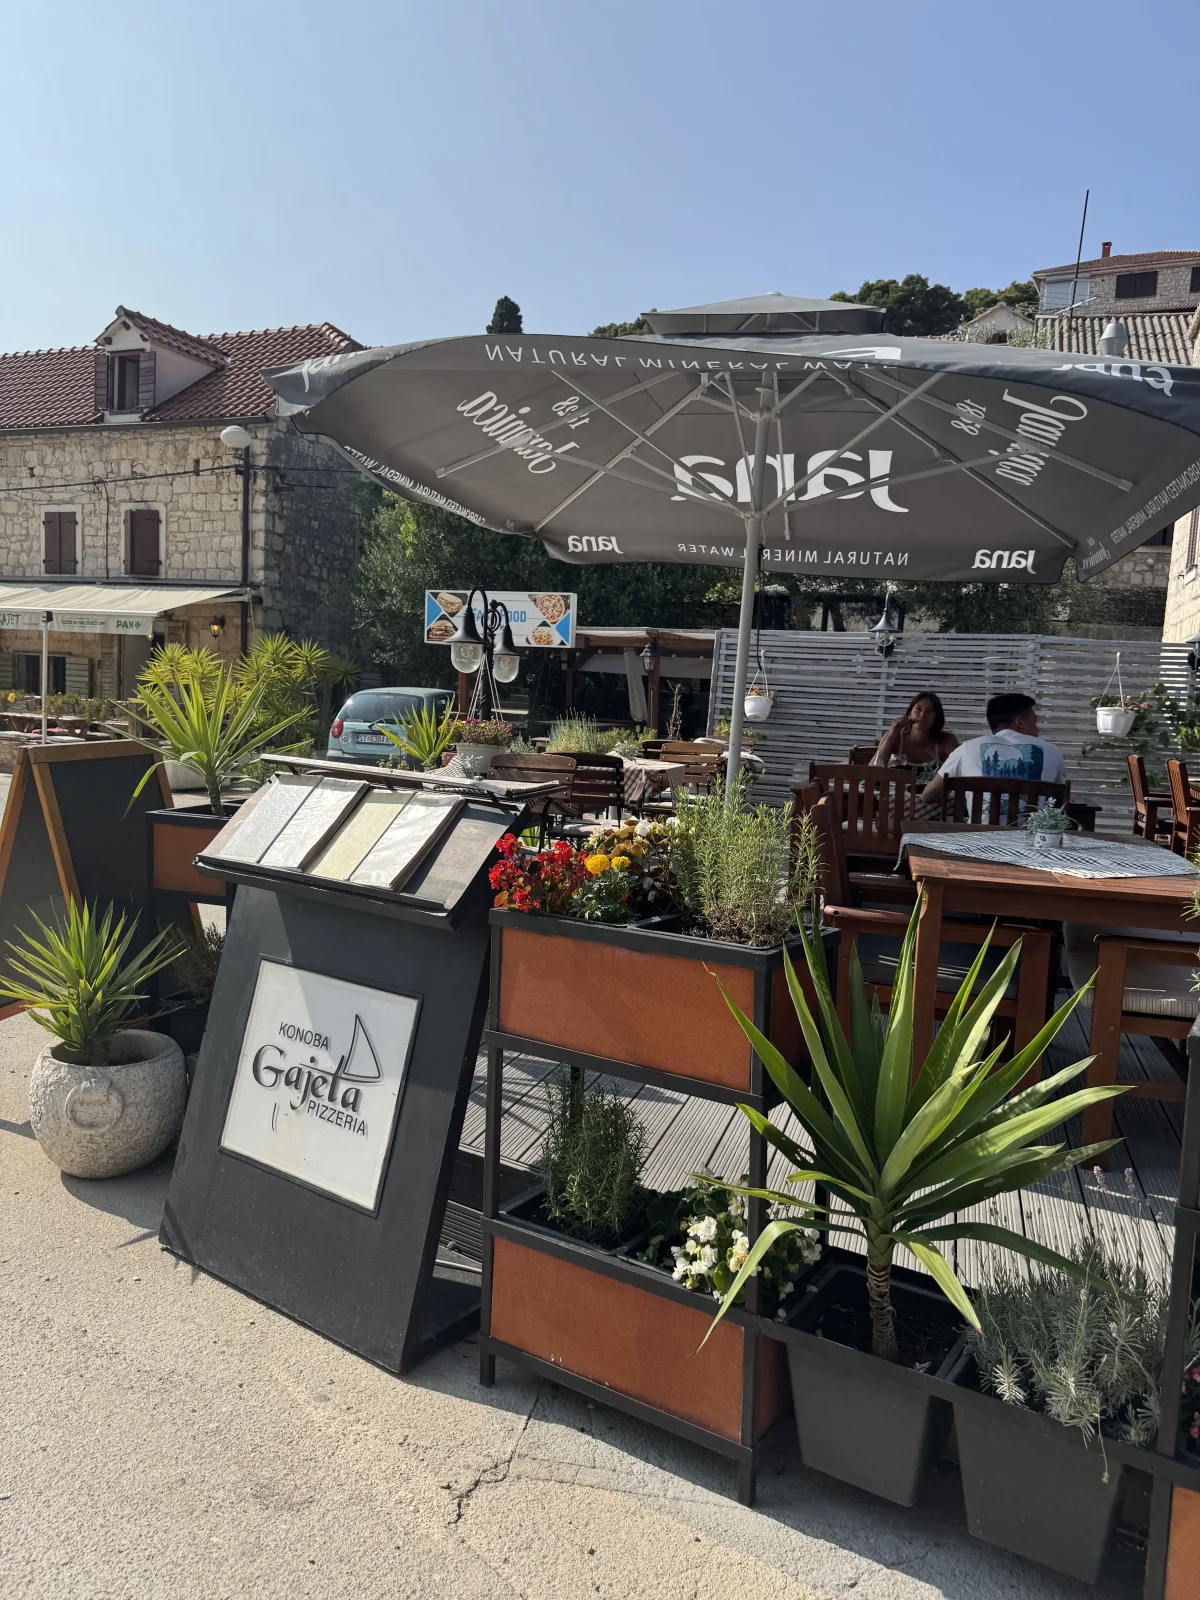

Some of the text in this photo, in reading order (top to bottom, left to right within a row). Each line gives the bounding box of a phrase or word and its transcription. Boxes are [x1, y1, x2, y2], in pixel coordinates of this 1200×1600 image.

[116, 620, 134, 629] PAN
[278, 1021, 330, 1051] KONOBA
[252, 1044, 362, 1113] Gajeta
[306, 1100, 366, 1137] PIZZERIA
